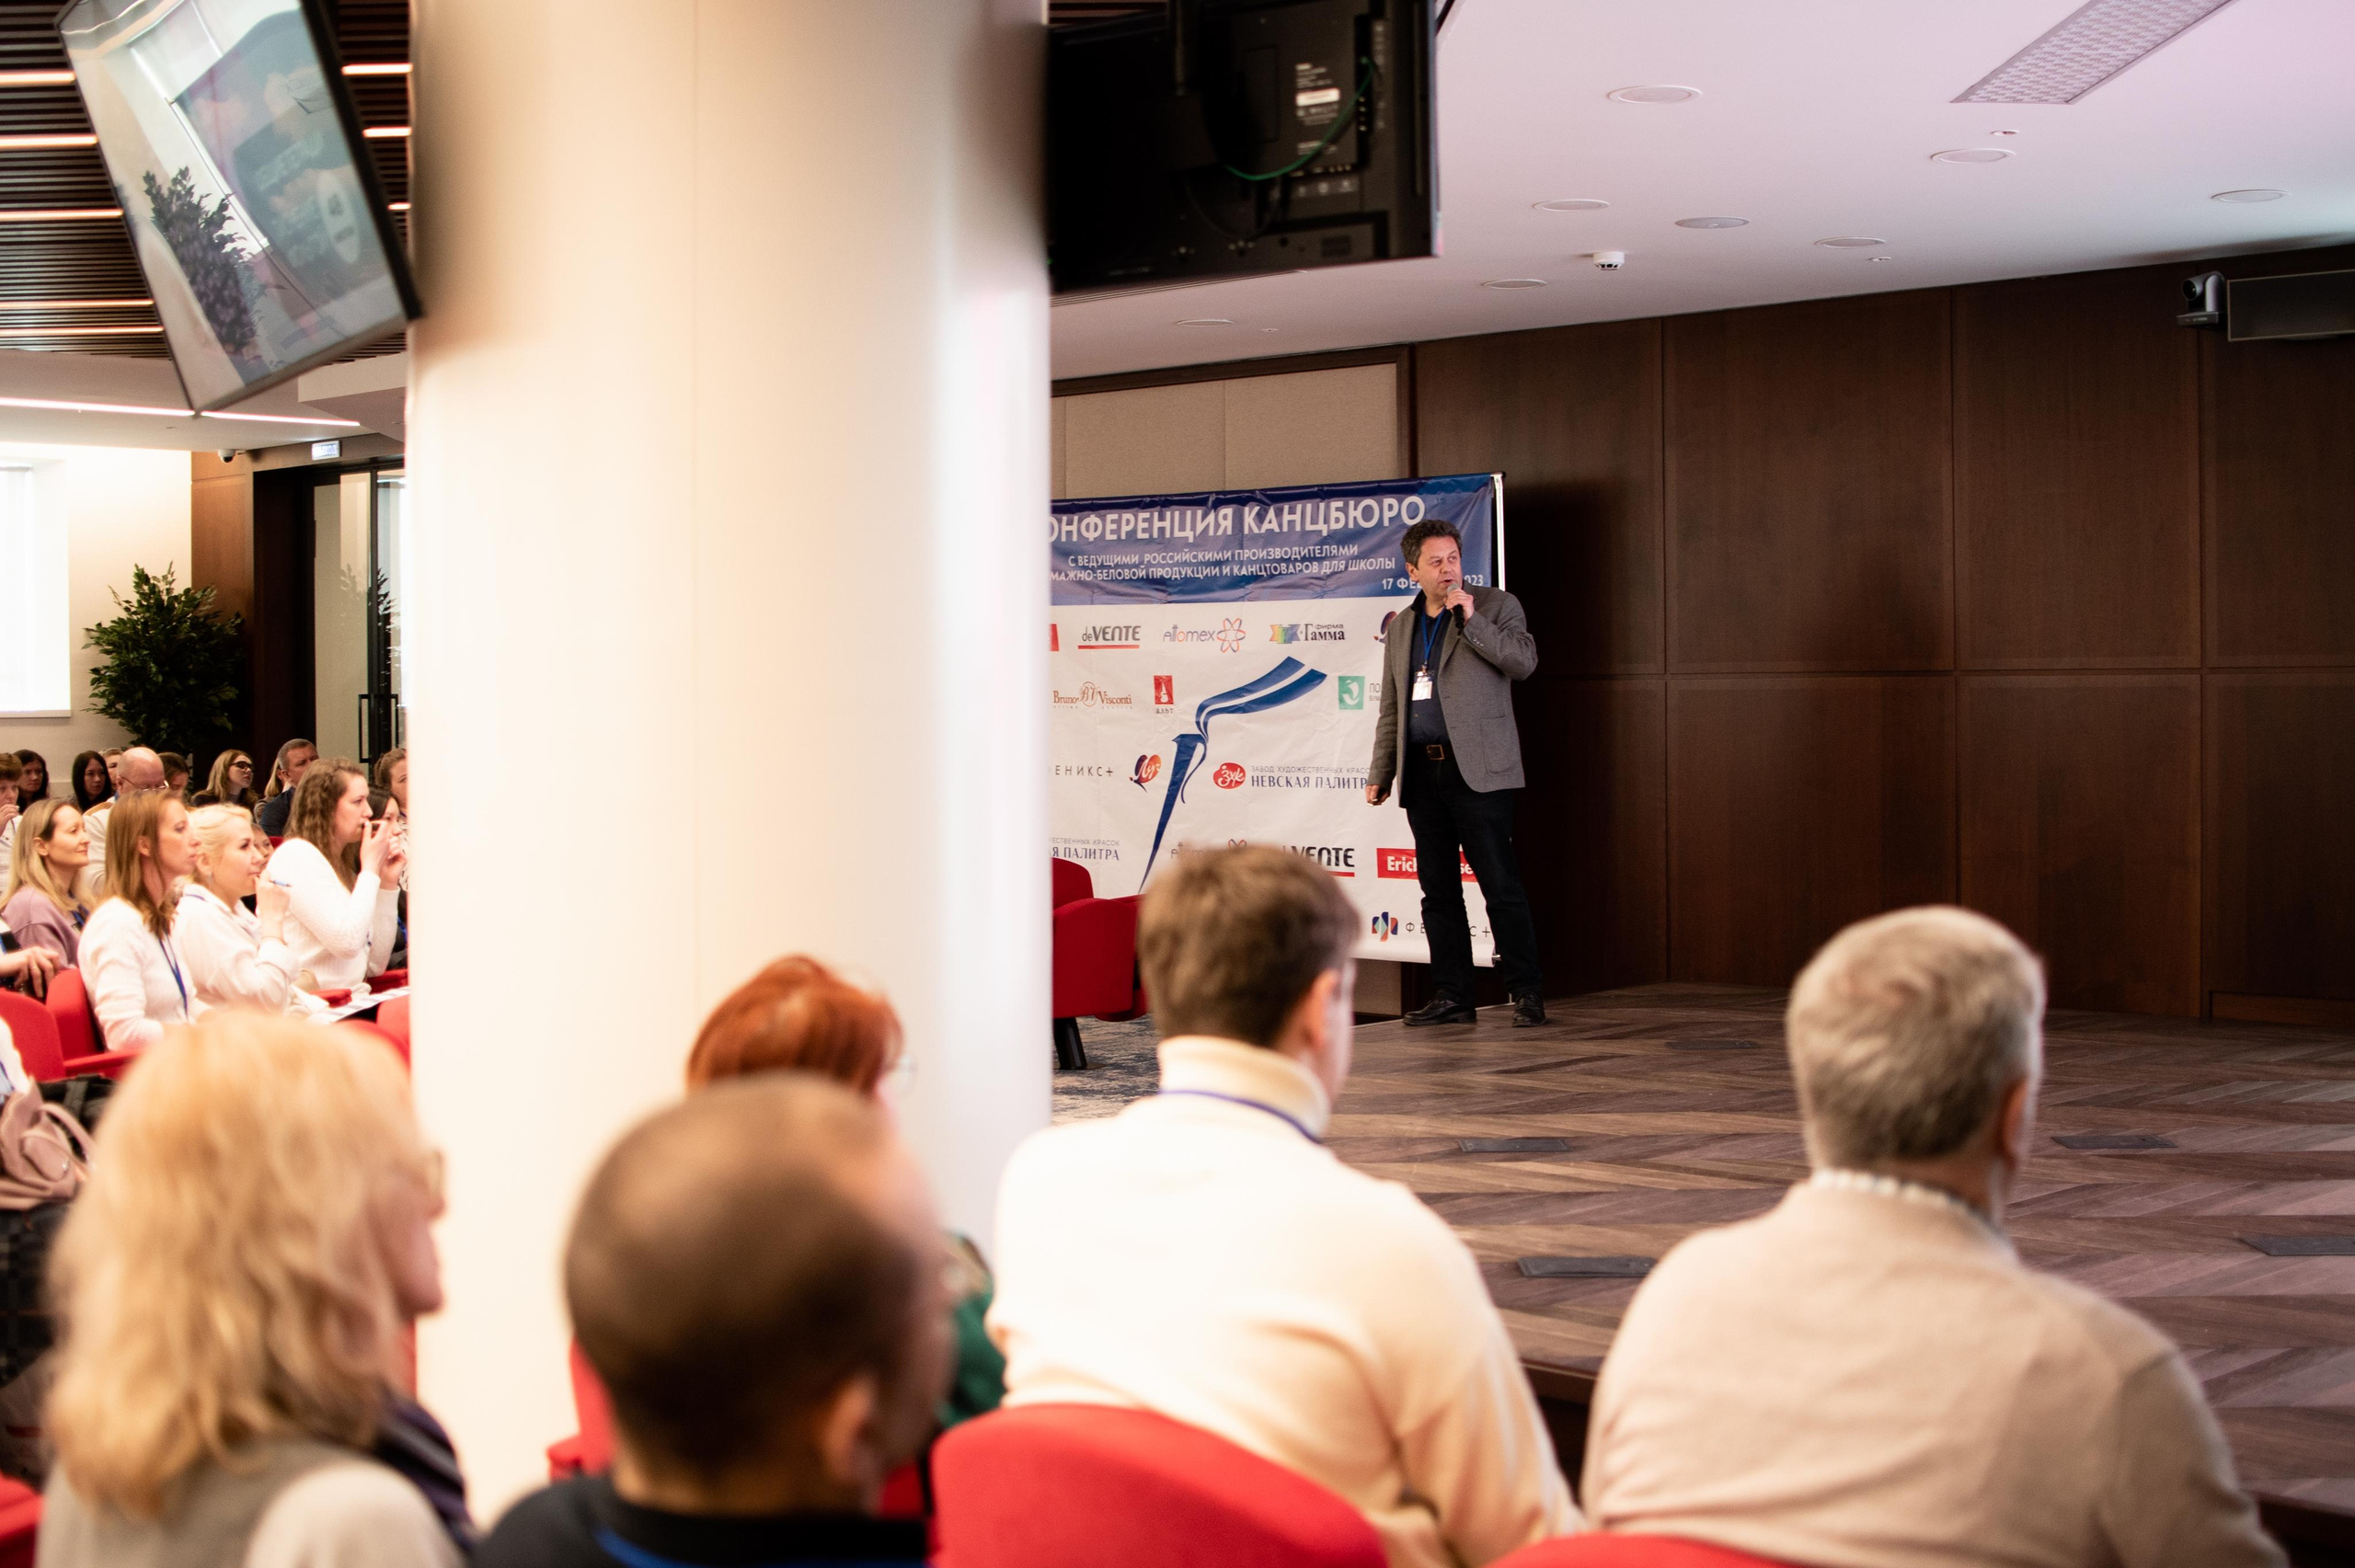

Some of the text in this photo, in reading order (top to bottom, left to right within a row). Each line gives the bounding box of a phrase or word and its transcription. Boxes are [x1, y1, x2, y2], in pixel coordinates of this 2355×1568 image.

[1244, 496, 1426, 536] КАНЦБЮРО
[1068, 544, 1359, 567] С ВЕДУЩИМИ РОССИЙСКИМИ ПРОИЗВОДИТЕЛЯМИ
[1149, 566, 1220, 581] ПРОДУКЦИИ
[1223, 566, 1231, 577] И
[1234, 561, 1319, 578] КАНЦТОВАРОВ
[1321, 560, 1346, 575] ДЛЯ
[1348, 557, 1396, 571] ШКОЛЫ
[1382, 578, 1394, 590] 17
[1304, 624, 1345, 641] Гамма
[1052, 690, 1080, 704] Bruno
[1097, 690, 1132, 704] Visconti
[1050, 764, 1114, 777] ЕНИКС+
[1251, 765, 1275, 773] ЗАВОД
[1277, 766, 1343, 774] ХУДОЖЕСТВЕННЫХ
[1251, 775, 1310, 788] НЕВСКАЯ
[1050, 837, 1120, 847] ЕСТВЕННЫХ КРАСОК
[1063, 846, 1120, 861] ПАЛИТРА
